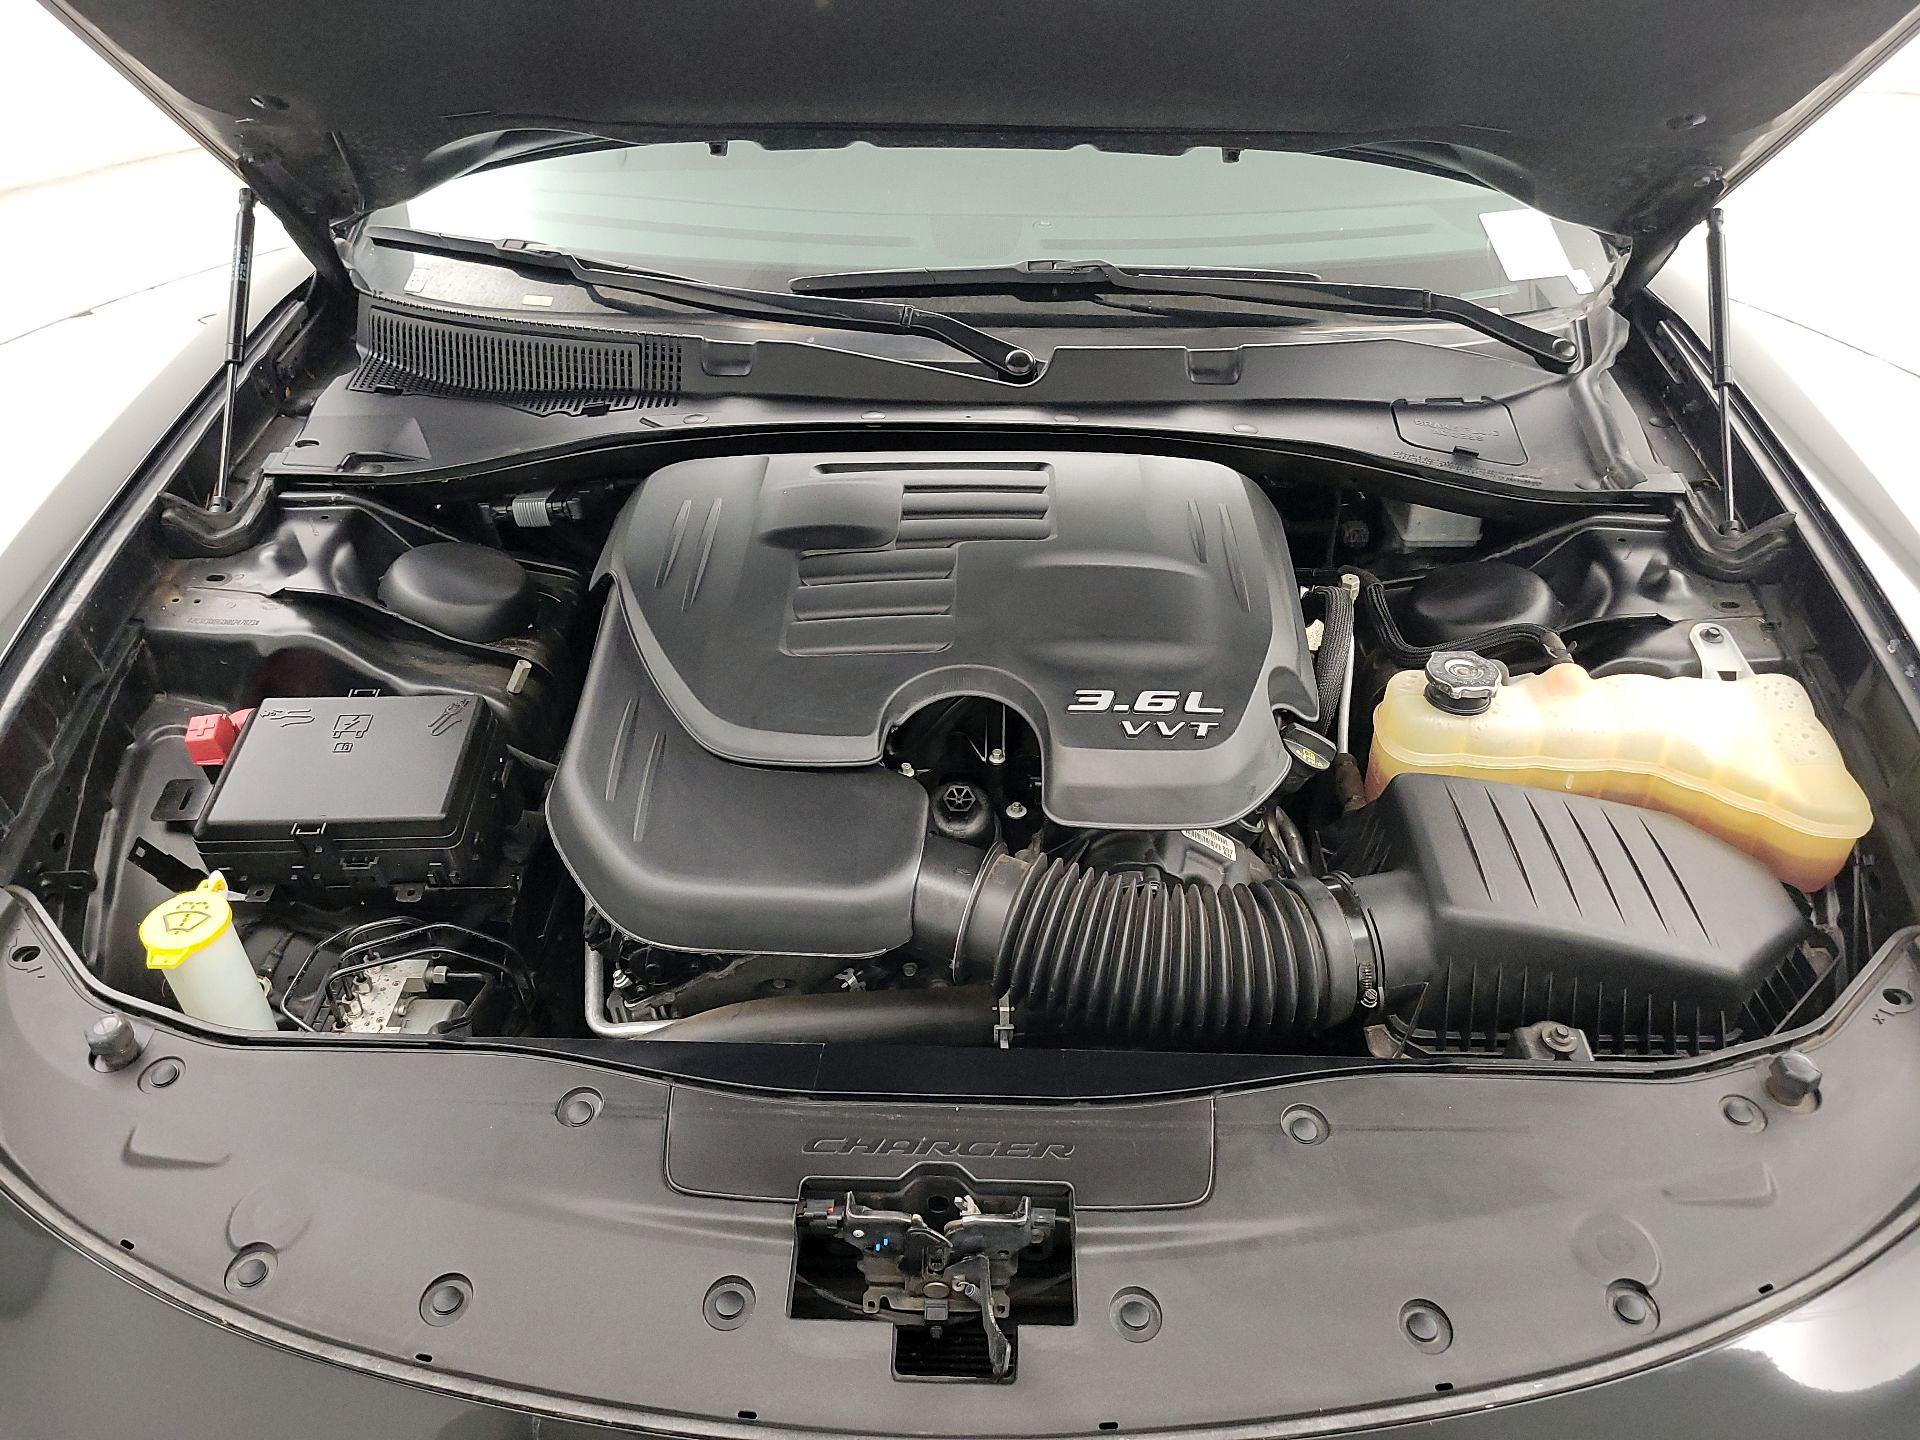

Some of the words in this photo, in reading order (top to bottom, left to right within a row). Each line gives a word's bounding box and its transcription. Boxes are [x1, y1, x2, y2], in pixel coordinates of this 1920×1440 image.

[1066, 689, 1225, 715] 3.6L
[1119, 720, 1220, 740] VVT
[801, 1136, 1076, 1160] CHARGER
